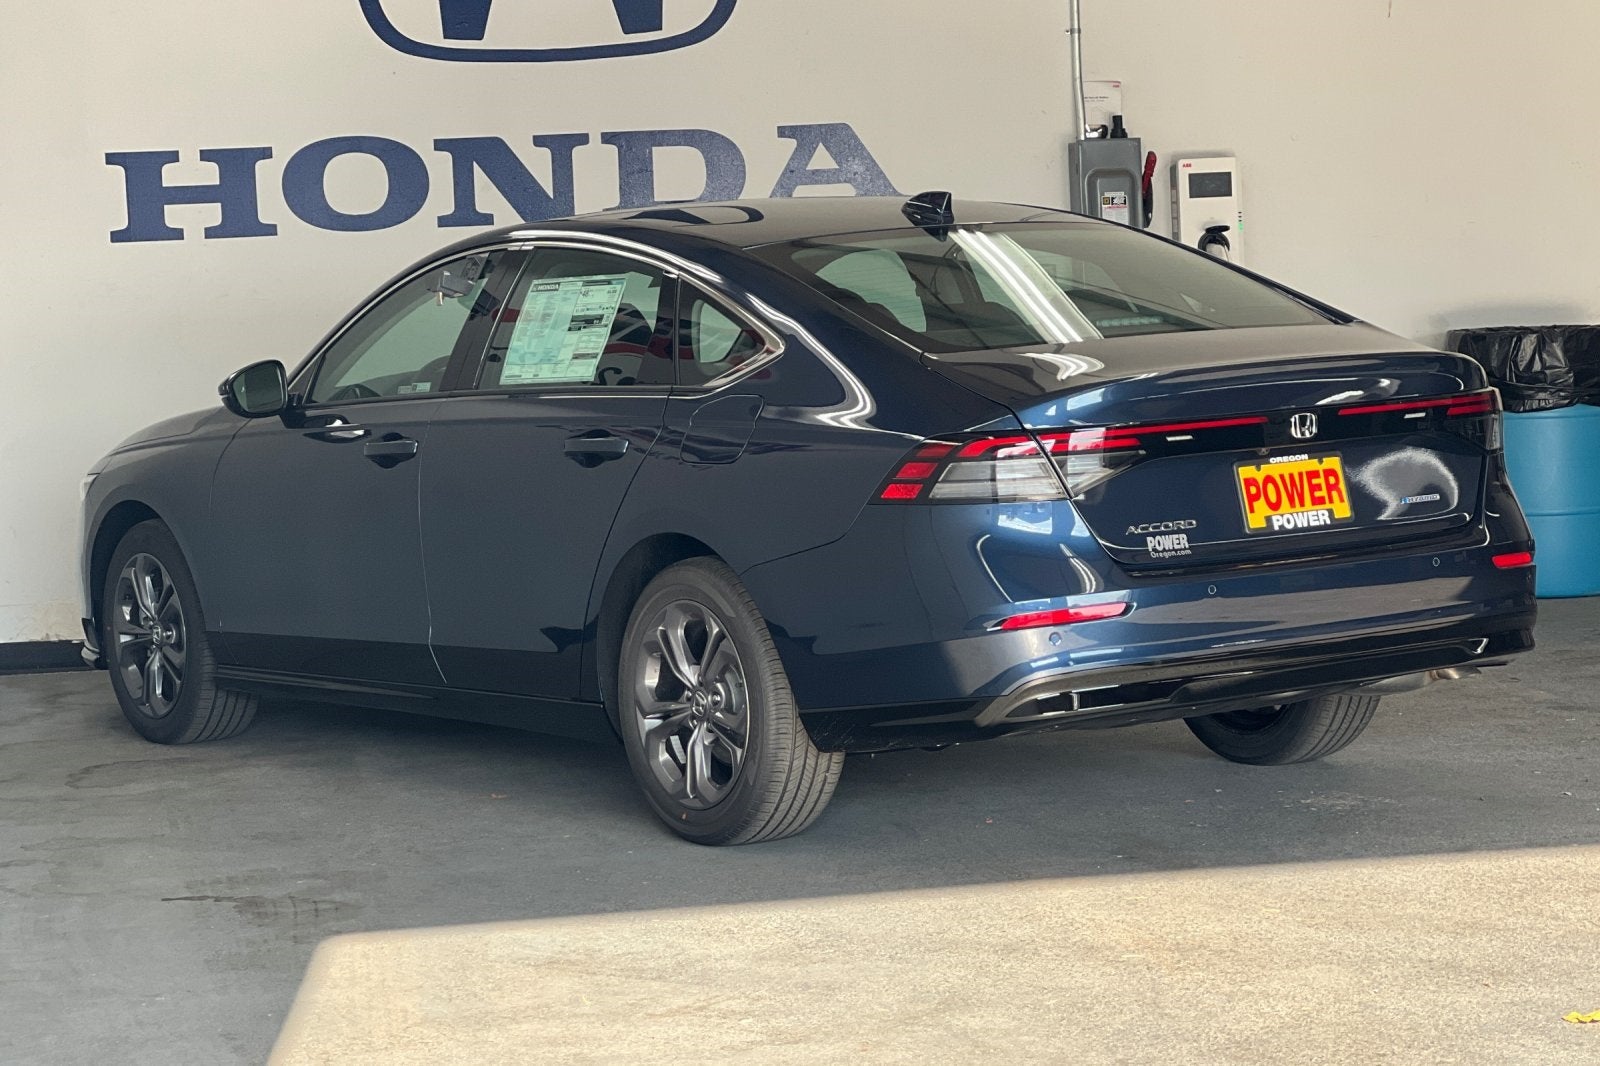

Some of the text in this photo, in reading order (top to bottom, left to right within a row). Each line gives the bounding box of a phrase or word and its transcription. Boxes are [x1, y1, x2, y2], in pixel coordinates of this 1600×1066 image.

[104, 122, 903, 243] HONDA
[1269, 453, 1309, 464] OREGON
[1243, 468, 1345, 514] POWER
[1125, 520, 1197, 536] ACCORD
[1271, 509, 1331, 531] POWER
[1146, 533, 1190, 552] POWER
[1150, 549, 1192, 559] Oregon.com
